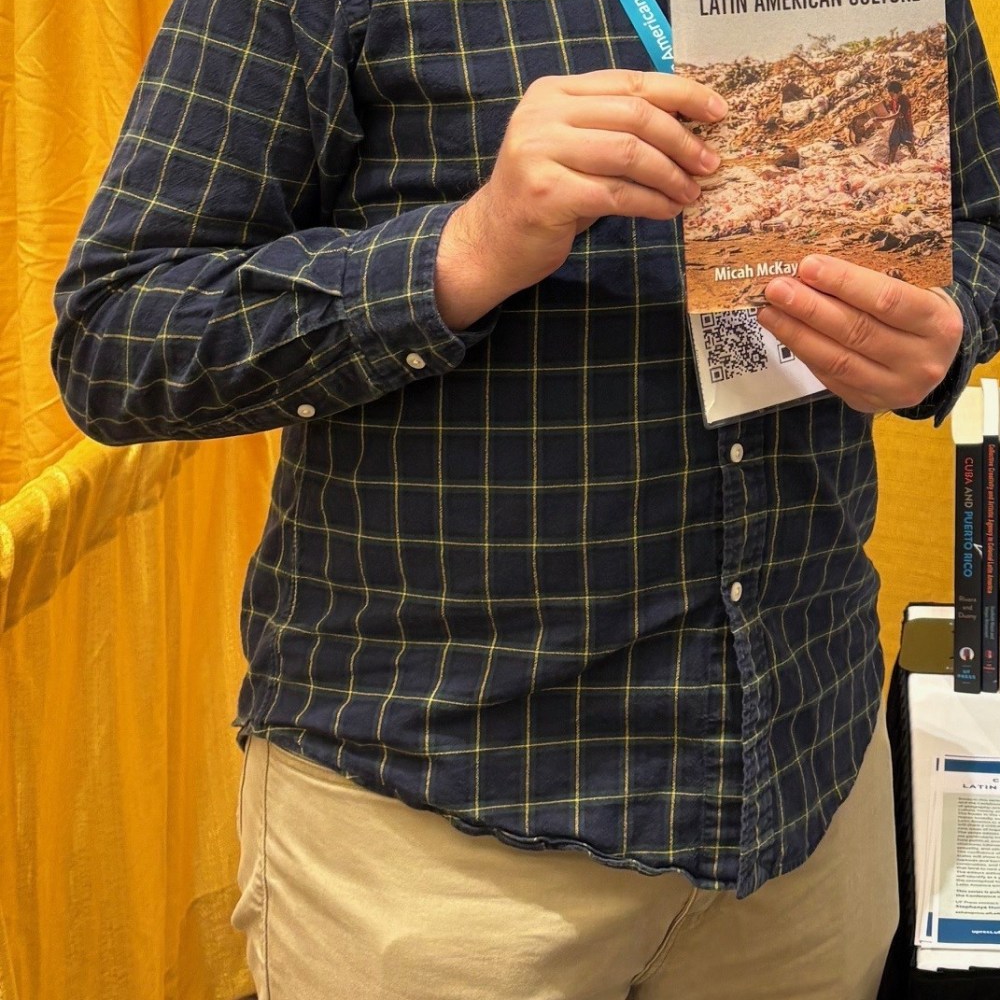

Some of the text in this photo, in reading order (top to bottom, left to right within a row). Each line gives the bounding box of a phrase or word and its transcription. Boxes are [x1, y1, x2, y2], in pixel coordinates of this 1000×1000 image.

[714, 260, 800, 282] Micah McKay
[963, 456, 975, 578] CUBA AND PUERTO RICO
